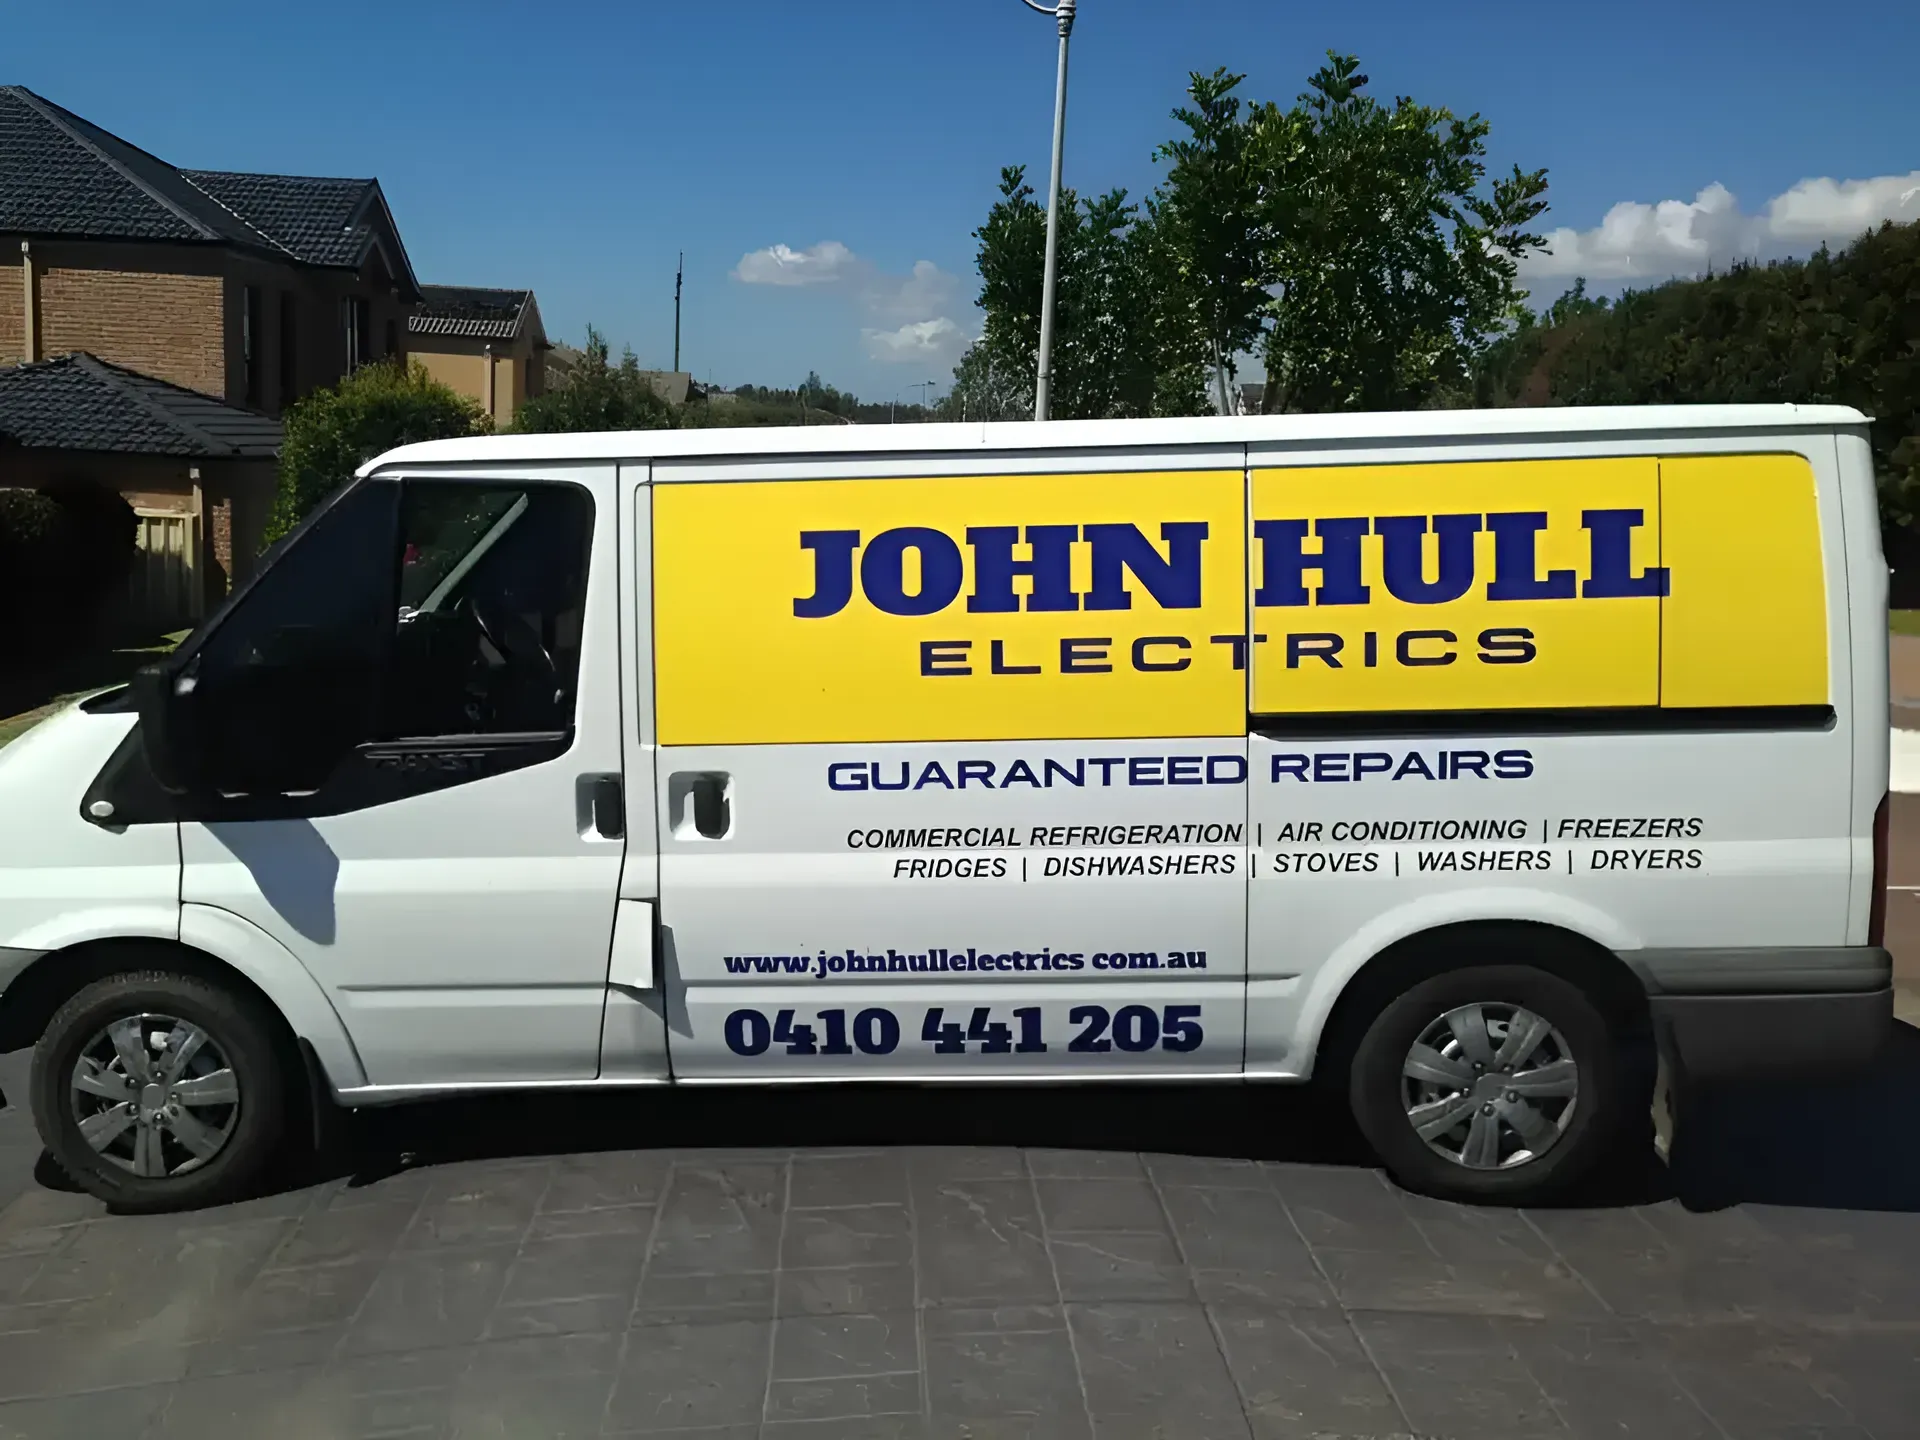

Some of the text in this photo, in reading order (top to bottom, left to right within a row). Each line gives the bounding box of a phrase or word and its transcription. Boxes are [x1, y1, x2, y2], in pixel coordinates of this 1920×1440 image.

[793, 508, 1671, 618] JOHN HULL
[919, 627, 1537, 677] ELECTRICS
[827, 749, 1534, 791] GUARANTEED REPAIRS
[846, 826, 1022, 849] COMMERCIAL
[1029, 822, 1243, 847] REFRIGERATION
[1276, 820, 1323, 843] AIR
[1330, 818, 1528, 842] CONDITIONING
[1556, 816, 1704, 839] FREEZERS
[892, 857, 1008, 880] FRIDGES
[1042, 853, 1237, 878] DISHWASHERS
[1272, 851, 1380, 874] STOVES
[1416, 849, 1552, 873] WASHERS
[1589, 847, 1703, 871] DRYERS
[724, 1004, 1204, 1056] 0410 441 205
